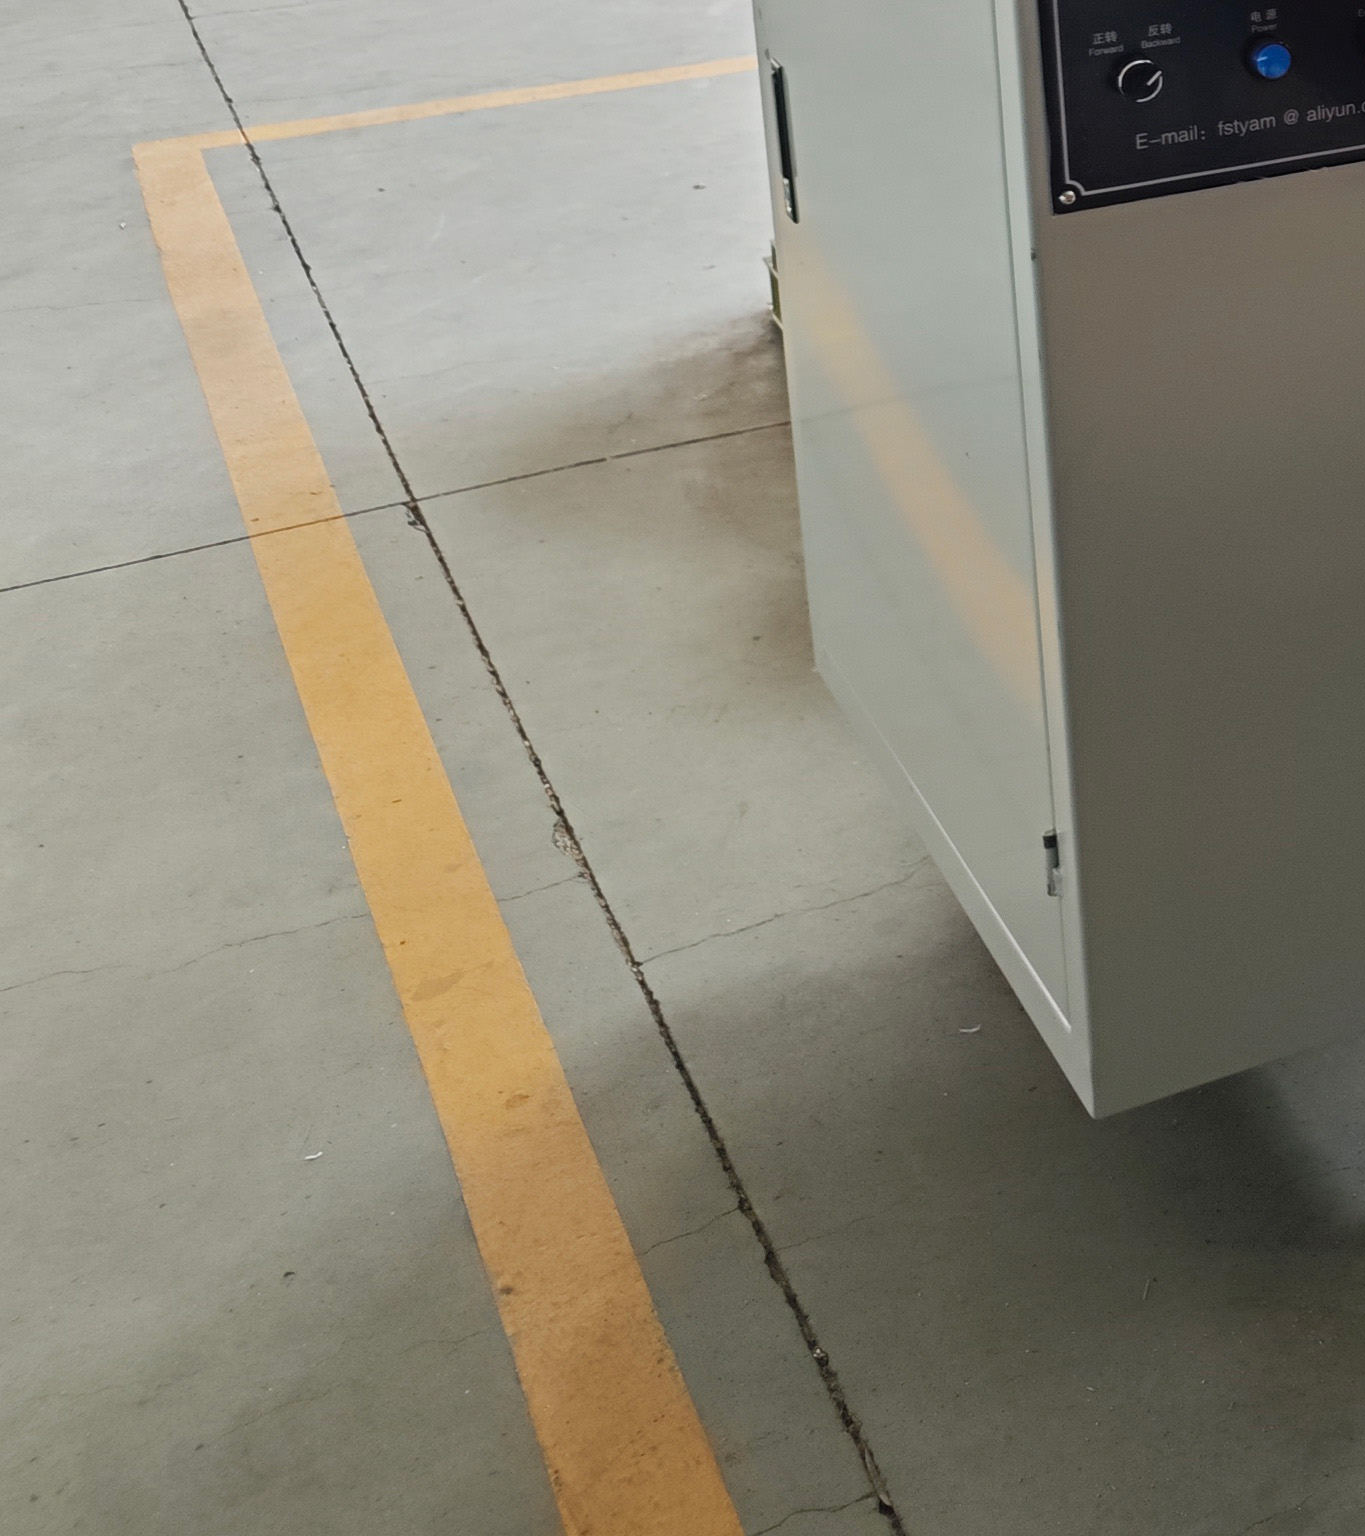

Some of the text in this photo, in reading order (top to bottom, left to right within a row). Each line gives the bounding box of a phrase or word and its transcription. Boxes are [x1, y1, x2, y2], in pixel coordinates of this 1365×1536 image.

[1250, 7, 1278, 23] 电源
[1147, 22, 1174, 38] 反转
[1251, 22, 1278, 34] Power
[1092, 29, 1119, 46] 正转
[1140, 36, 1181, 50] Backward
[1087, 44, 1124, 58] Forward
[1217, 114, 1277, 137] fstyam
[1282, 109, 1300, 126] @
